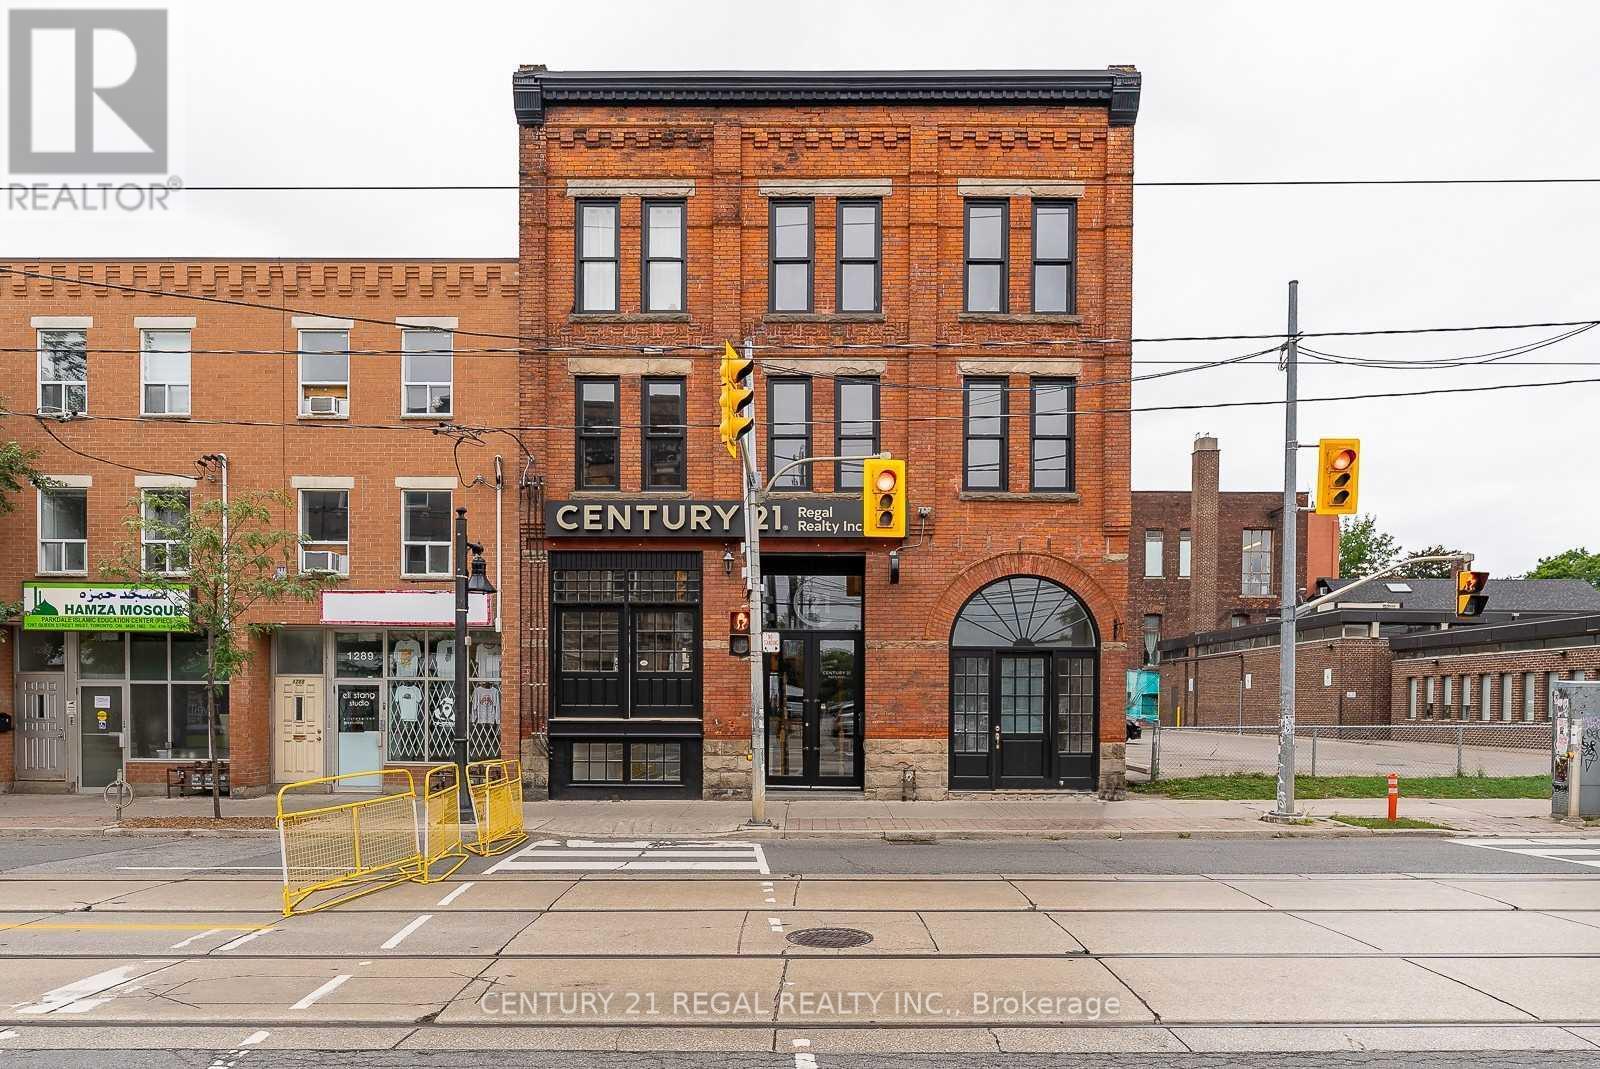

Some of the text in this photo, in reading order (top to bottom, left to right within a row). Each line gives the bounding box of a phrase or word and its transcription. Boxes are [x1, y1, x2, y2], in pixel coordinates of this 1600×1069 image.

[556, 505, 739, 530] CENTURY
[798, 506, 833, 522] Regal
[798, 520, 840, 535] Realty
[64, 604, 183, 616] HAMZA MOSQUE
[347, 651, 374, 661] 1289
